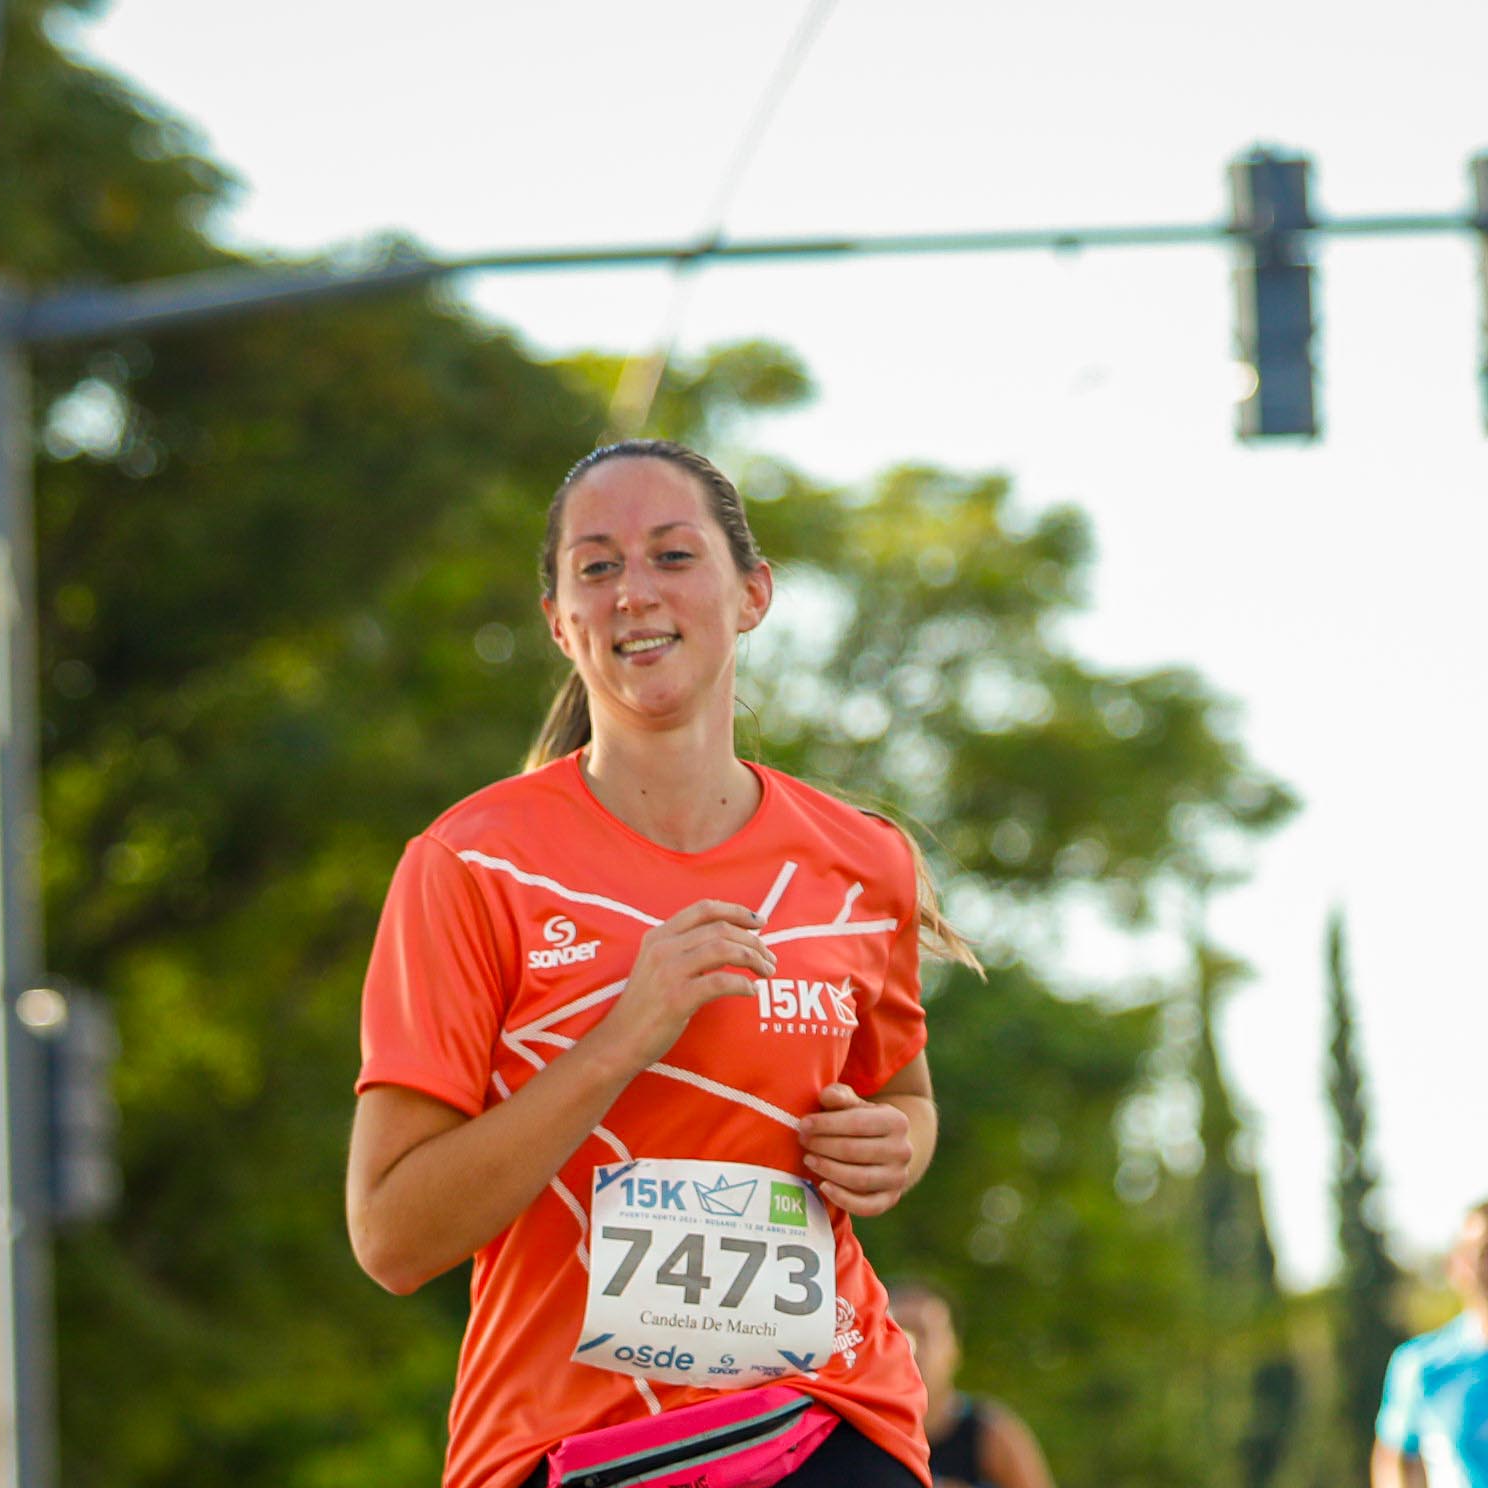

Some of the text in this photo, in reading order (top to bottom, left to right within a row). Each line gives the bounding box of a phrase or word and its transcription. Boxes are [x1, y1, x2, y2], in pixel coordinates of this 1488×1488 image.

[755, 978, 829, 1021] 15K
[759, 1022, 829, 1036] PUERTO
[620, 1177, 688, 1211] 15K
[773, 1194, 804, 1215] 10K
[602, 1226, 824, 1316] 7473
[640, 1310, 778, 1337] Candela De Marchi
[614, 1345, 695, 1370] osde
